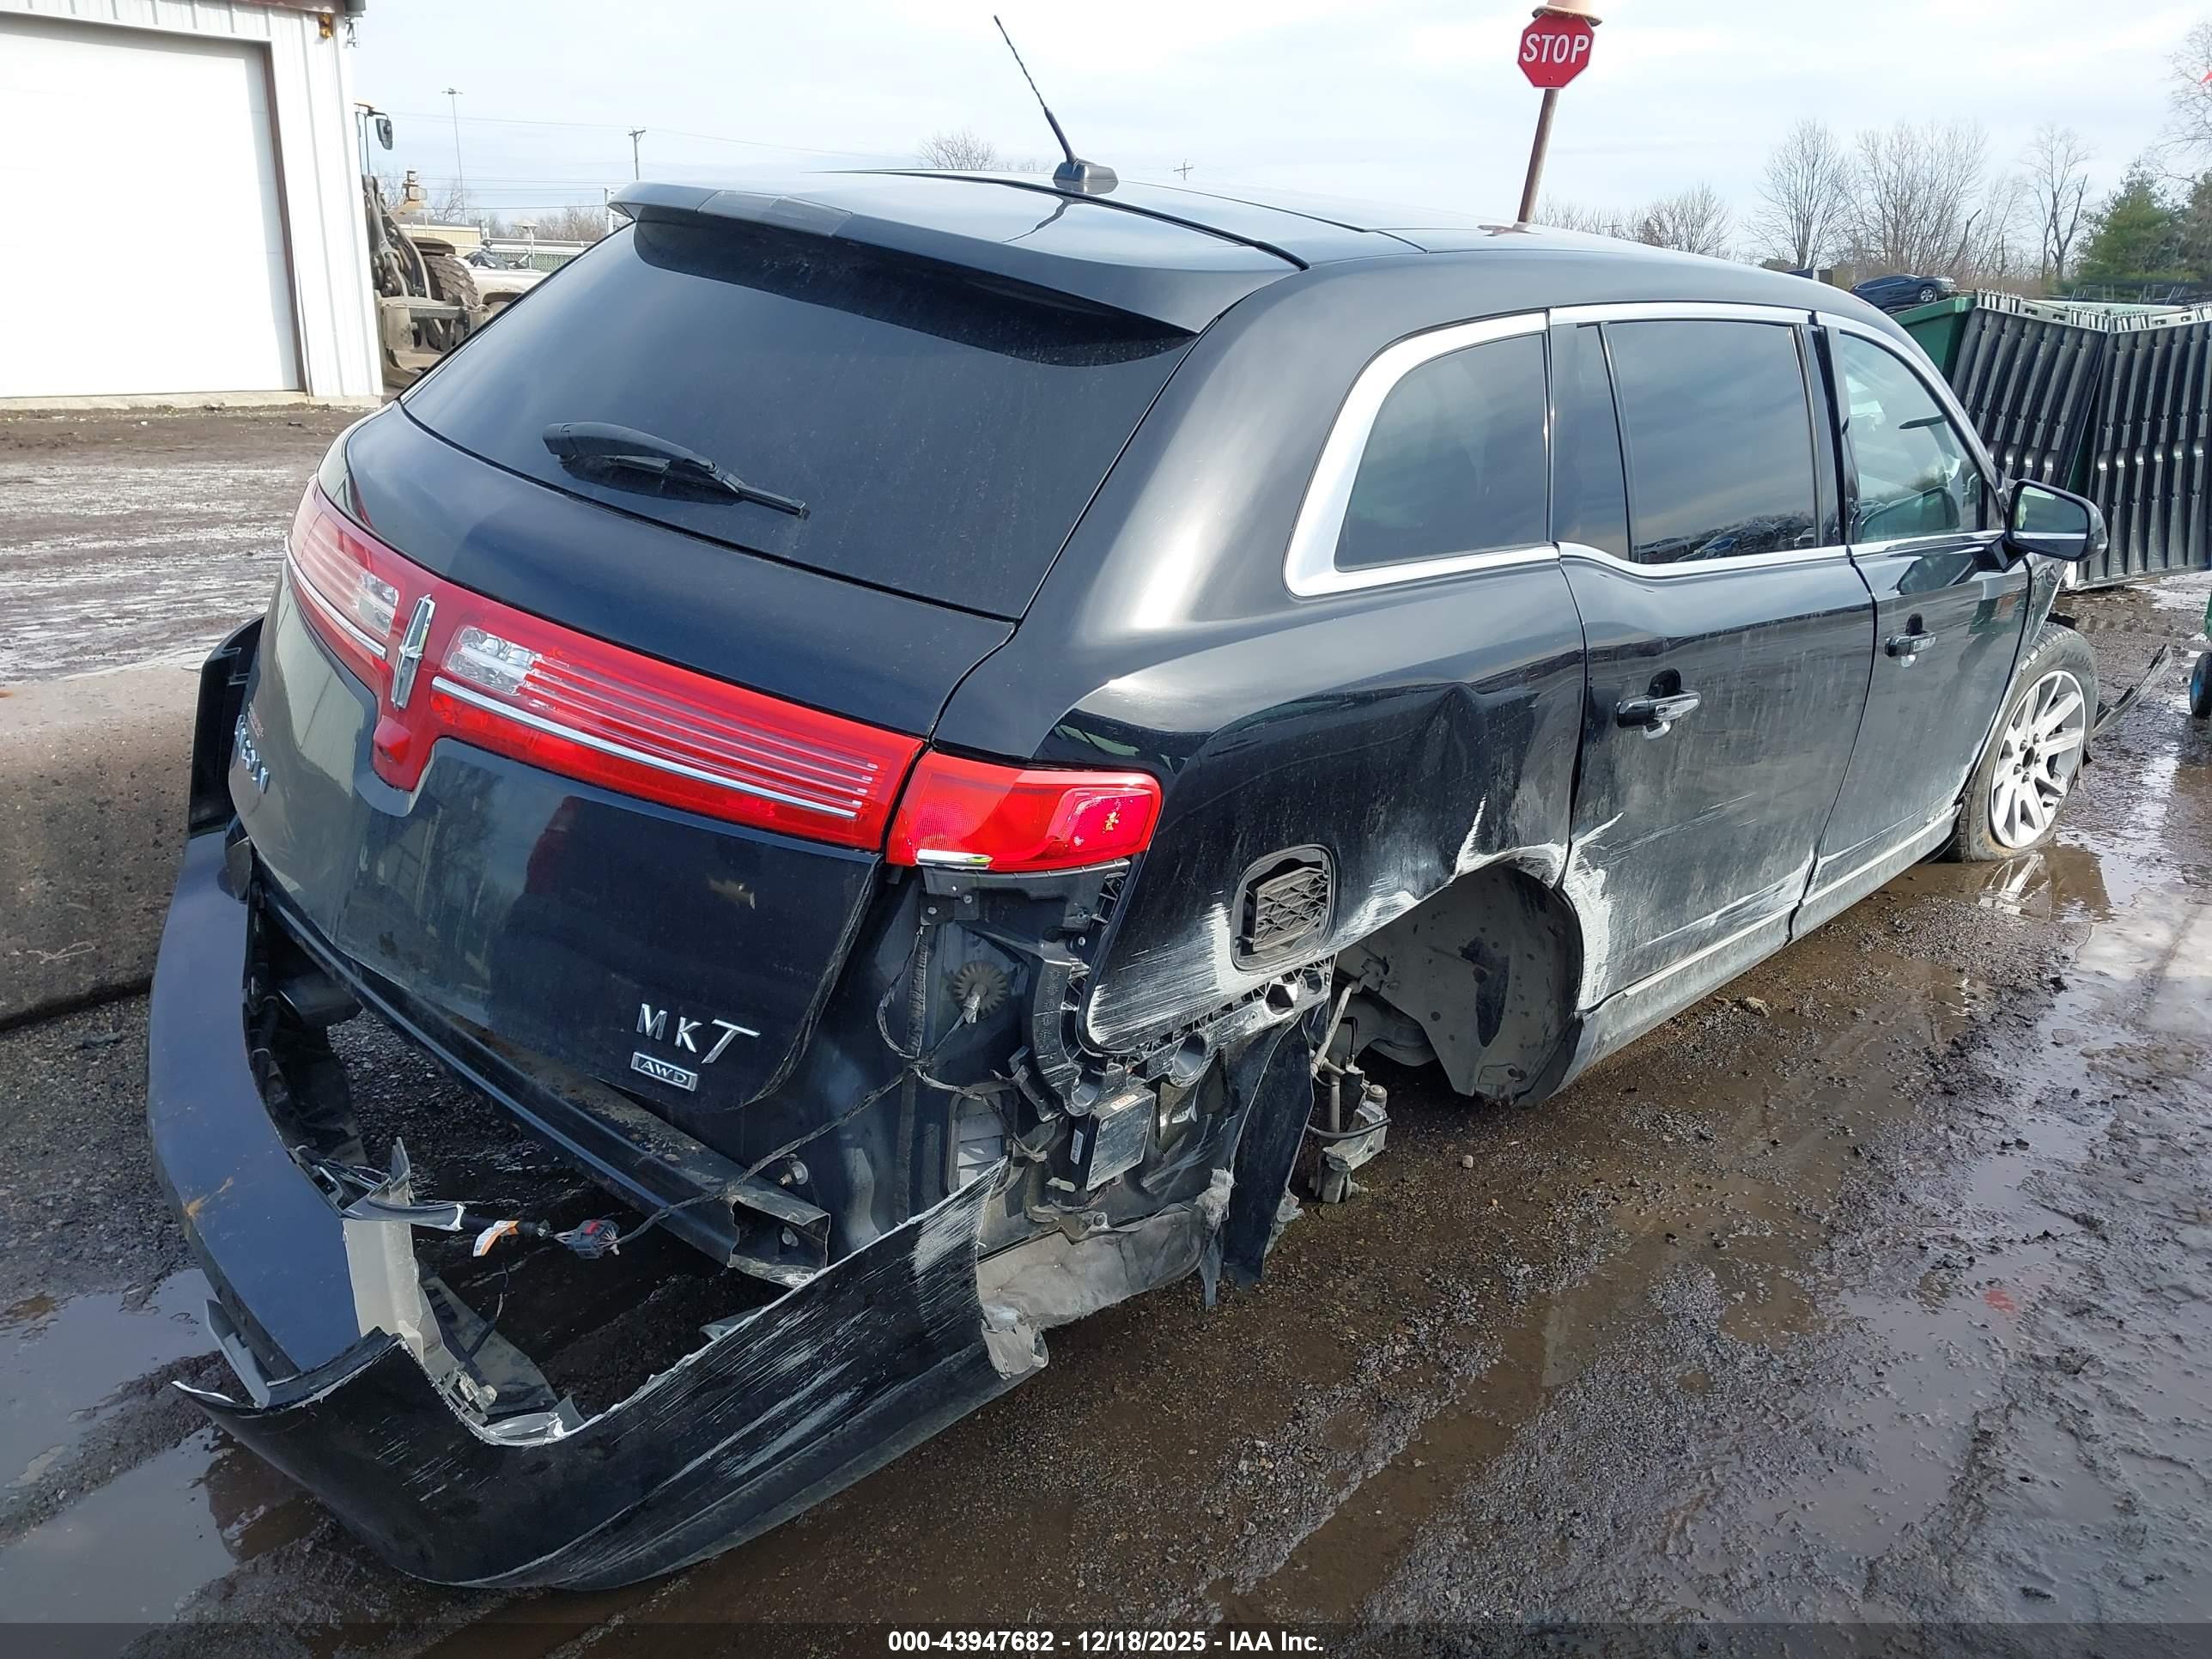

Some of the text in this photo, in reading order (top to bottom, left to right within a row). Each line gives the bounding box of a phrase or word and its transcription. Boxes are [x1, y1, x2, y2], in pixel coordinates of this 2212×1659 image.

[1522, 33, 1589, 64] STOP
[636, 1003, 762, 1065] MKT
[640, 1060, 688, 1084] AWD
